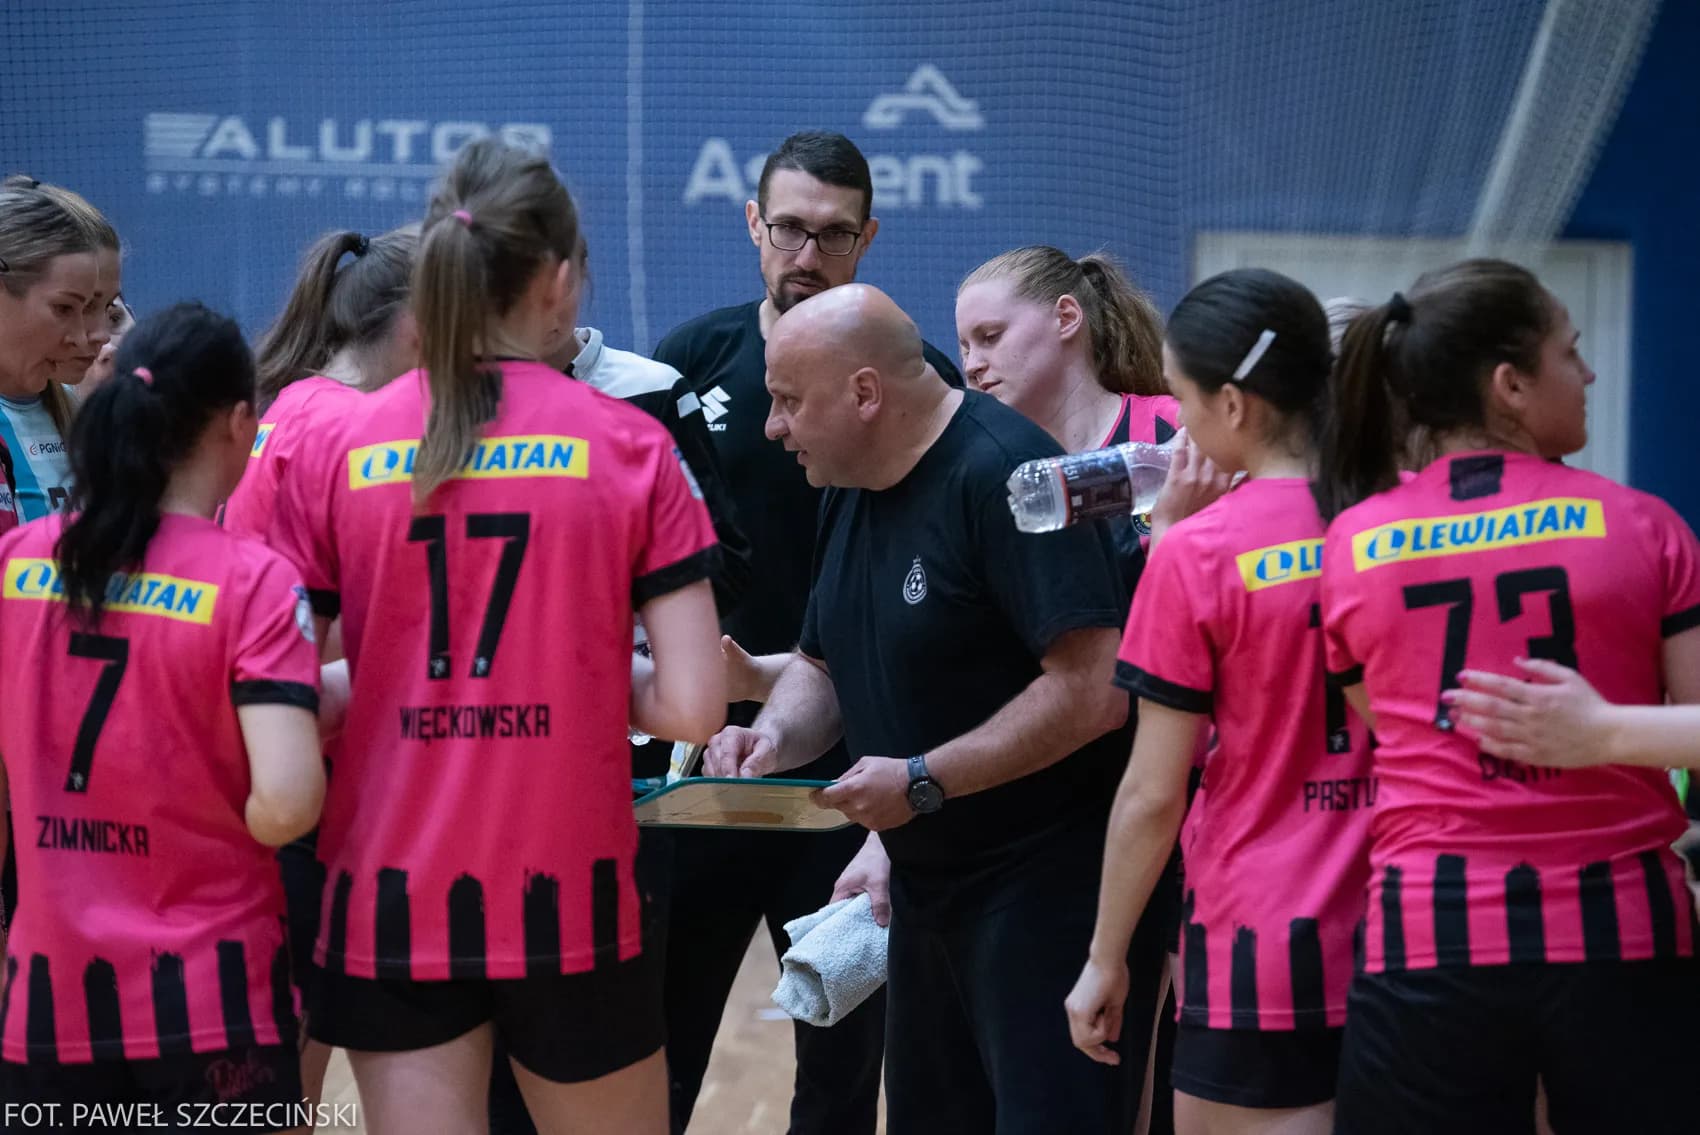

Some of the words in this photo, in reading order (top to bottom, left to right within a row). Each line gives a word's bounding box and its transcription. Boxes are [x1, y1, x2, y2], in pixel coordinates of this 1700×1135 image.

[682, 136, 984, 209] Aent
[403, 442, 574, 474] LIATAN
[1411, 504, 1588, 552] LEWIATAN
[407, 512, 531, 680] 17
[1403, 565, 1579, 732] 73
[64, 631, 129, 793] 7
[400, 703, 550, 745] WIĘCKOWSKA
[36, 815, 149, 857] ZIMNICKA
